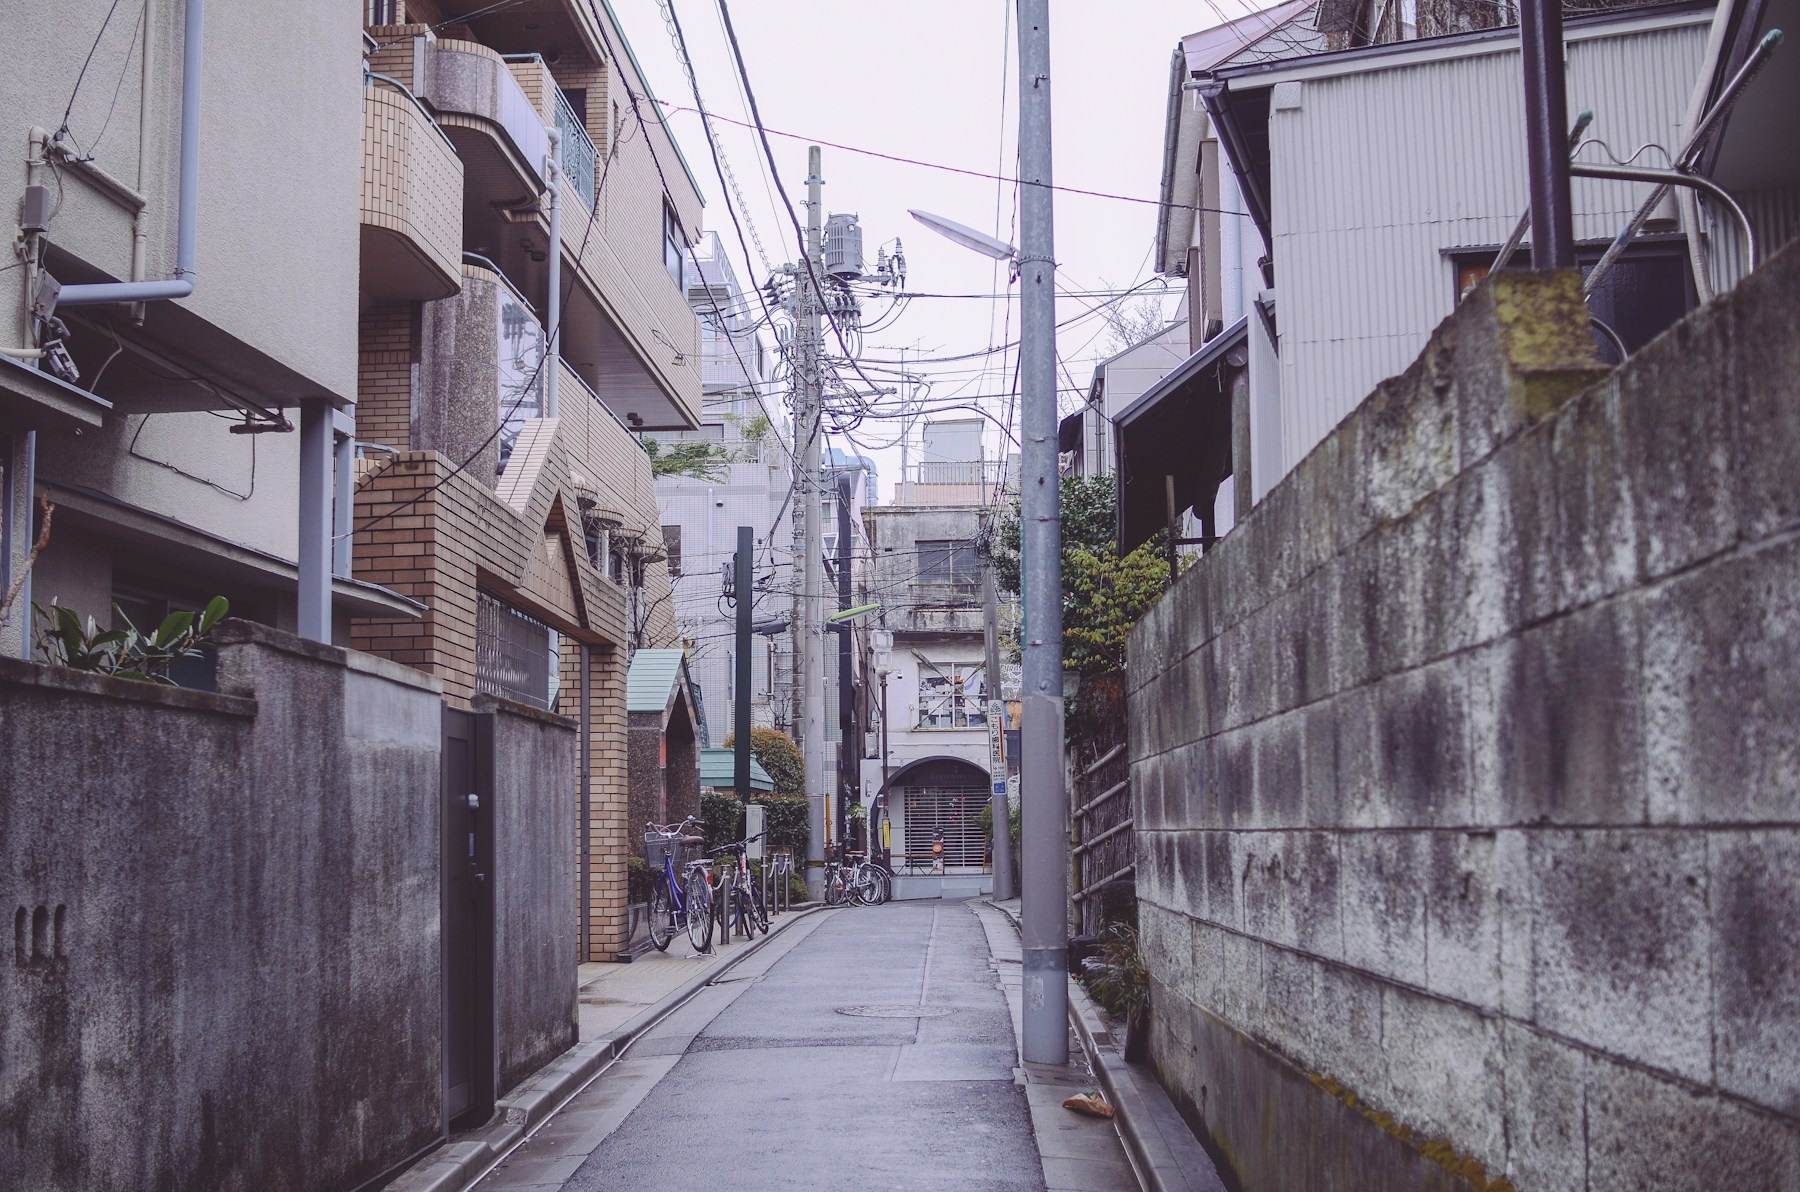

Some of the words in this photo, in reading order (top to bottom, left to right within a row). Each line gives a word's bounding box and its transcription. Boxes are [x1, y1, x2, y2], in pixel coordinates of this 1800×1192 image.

[991, 716, 1000, 763] こもり歯科医院
